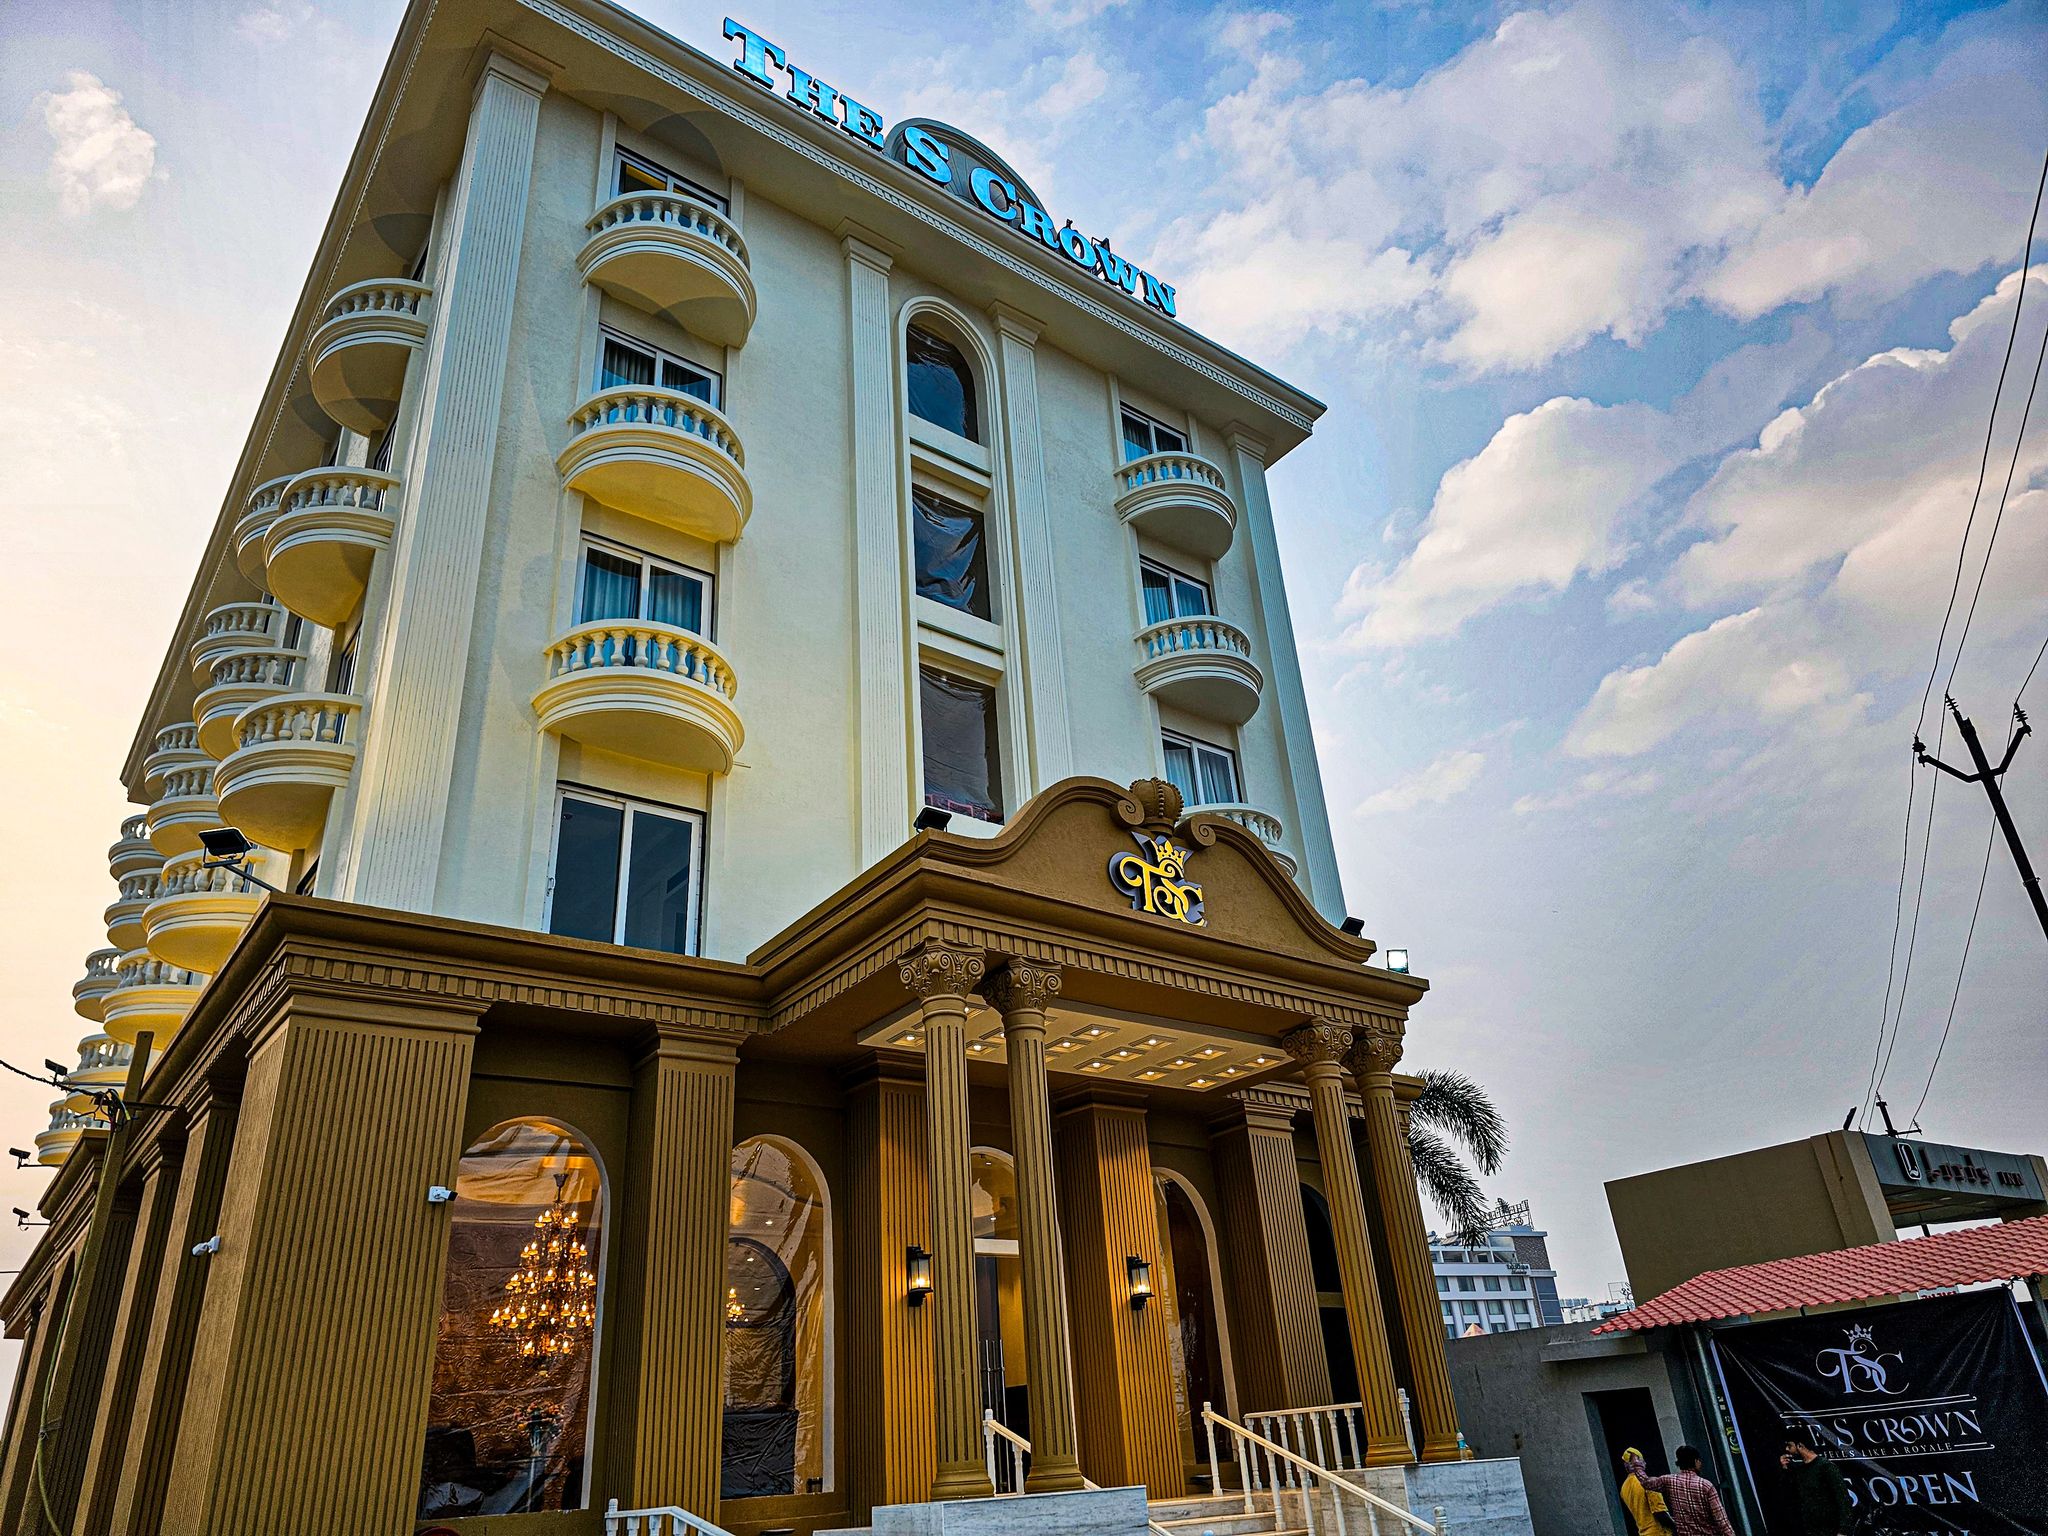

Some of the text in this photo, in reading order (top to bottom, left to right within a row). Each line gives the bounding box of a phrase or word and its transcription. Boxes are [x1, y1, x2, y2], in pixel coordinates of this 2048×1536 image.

[722, 16, 1177, 317] THE S CROWN
[1863, 1409, 1983, 1444] CROWN
[1862, 1447, 1887, 1457] LIKE
[1893, 1447, 1900, 1455] A
[1904, 1442, 1952, 1455] ROYALE
[1863, 1471, 1980, 1506] OPEN
